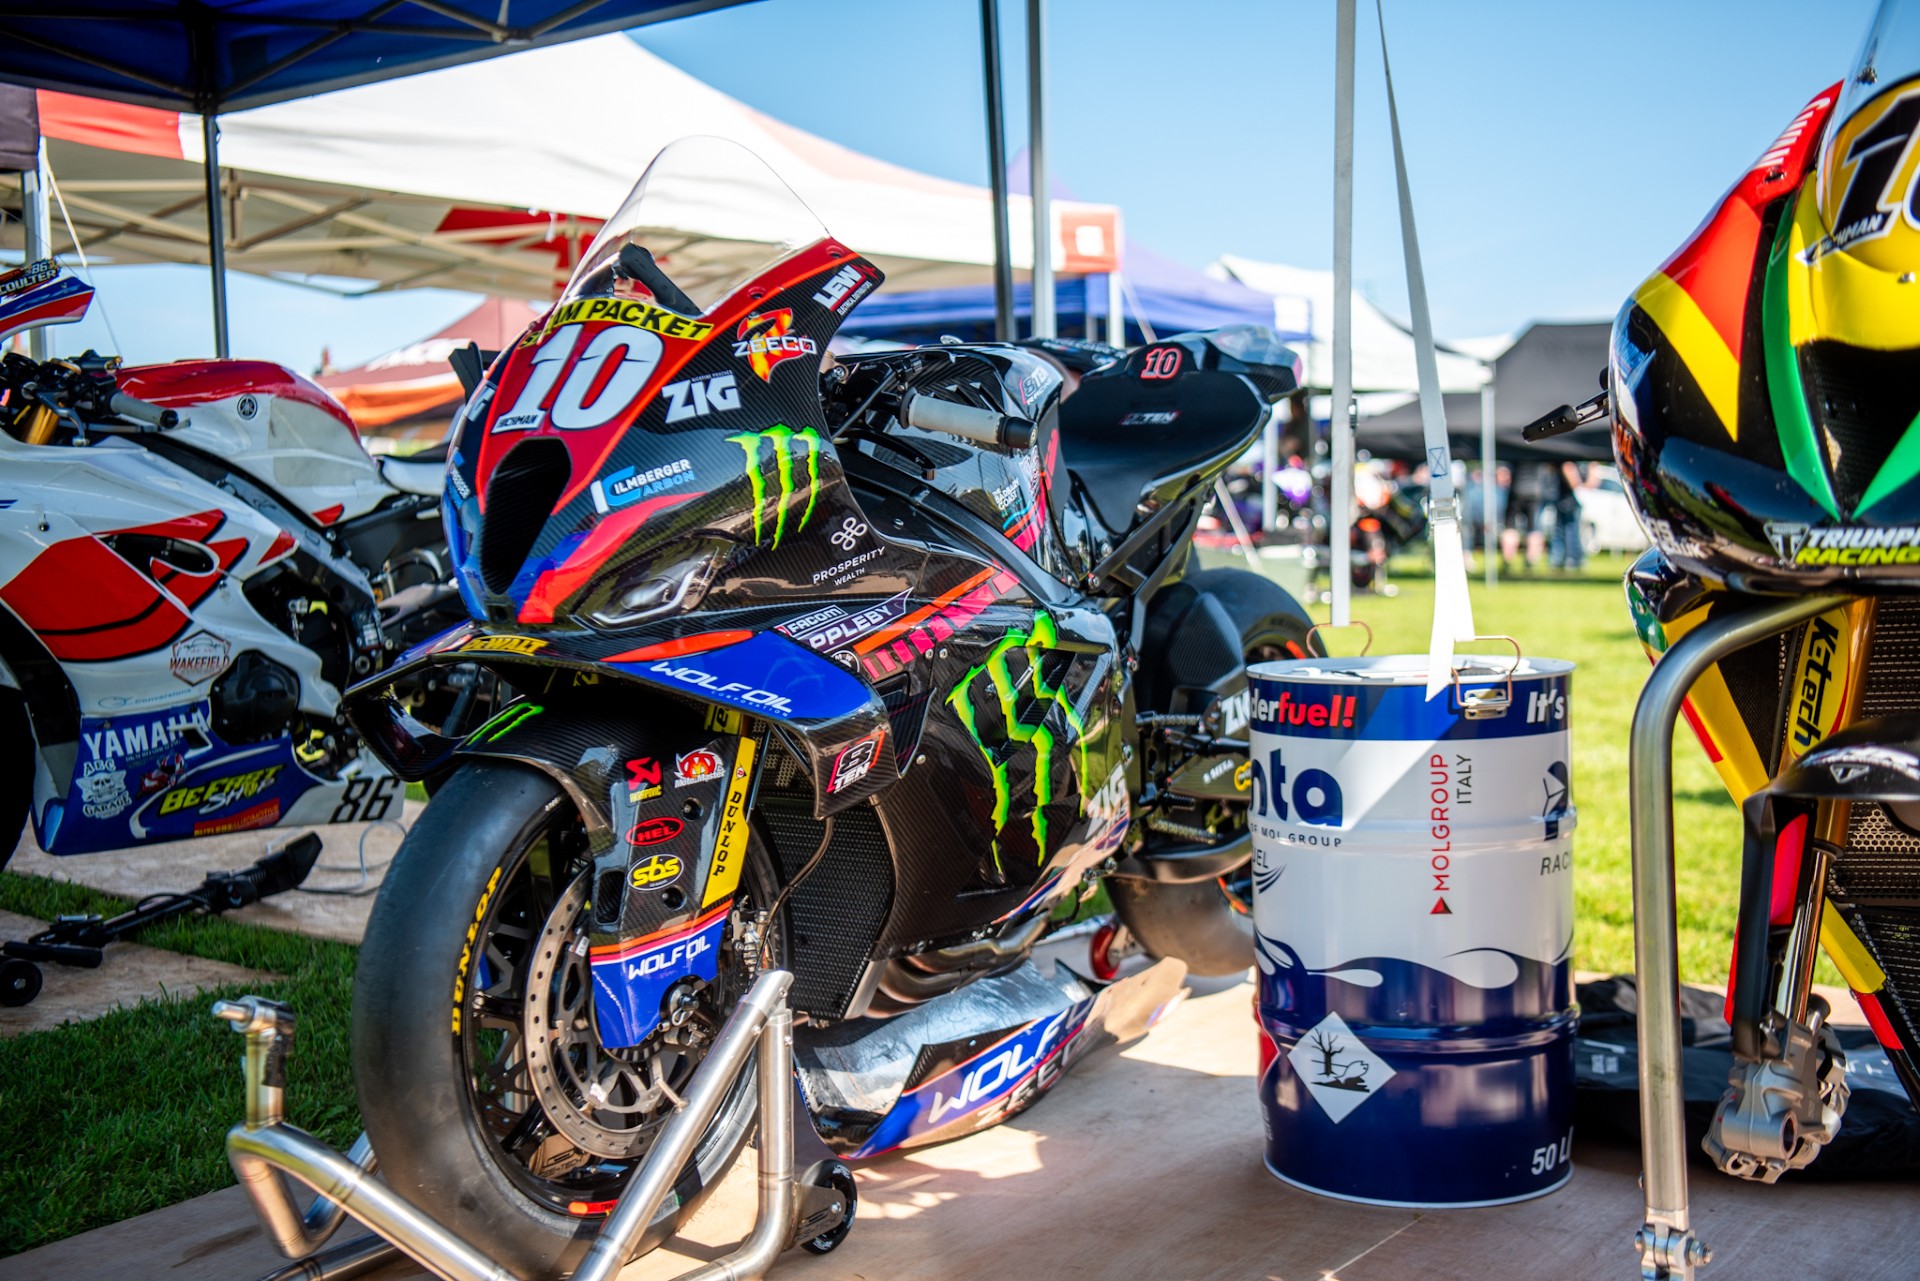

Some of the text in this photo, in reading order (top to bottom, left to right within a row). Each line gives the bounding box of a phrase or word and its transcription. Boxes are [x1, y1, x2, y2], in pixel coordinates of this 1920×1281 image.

[812, 263, 864, 310] LEW
[588, 300, 713, 339] PACKET
[732, 335, 818, 358] ZEECO
[1141, 348, 1182, 379] 10
[491, 323, 666, 431] 10
[661, 374, 742, 424] ZIG
[812, 546, 886, 584] PROSPERITY
[1795, 547, 1920, 565] RACING
[834, 567, 866, 587] WEALTH
[787, 607, 843, 633] FACOM
[169, 655, 231, 671] WAKEFIELD
[710, 689, 789, 718] CORPORATION
[1526, 689, 1565, 724] It's
[82, 709, 210, 760] YAMAHA
[198, 777, 276, 815] SHOP
[1455, 753, 1473, 805] ITALY
[82, 790, 133, 818] GARAGE
[327, 775, 401, 824] 86
[636, 824, 675, 843] HEL
[712, 790, 743, 877] DUNLOP
[1429, 753, 1451, 892] MOLGROUP
[1288, 832, 1342, 848] GROUP
[632, 855, 680, 888] sbs
[1530, 1142, 1558, 1176] 50
